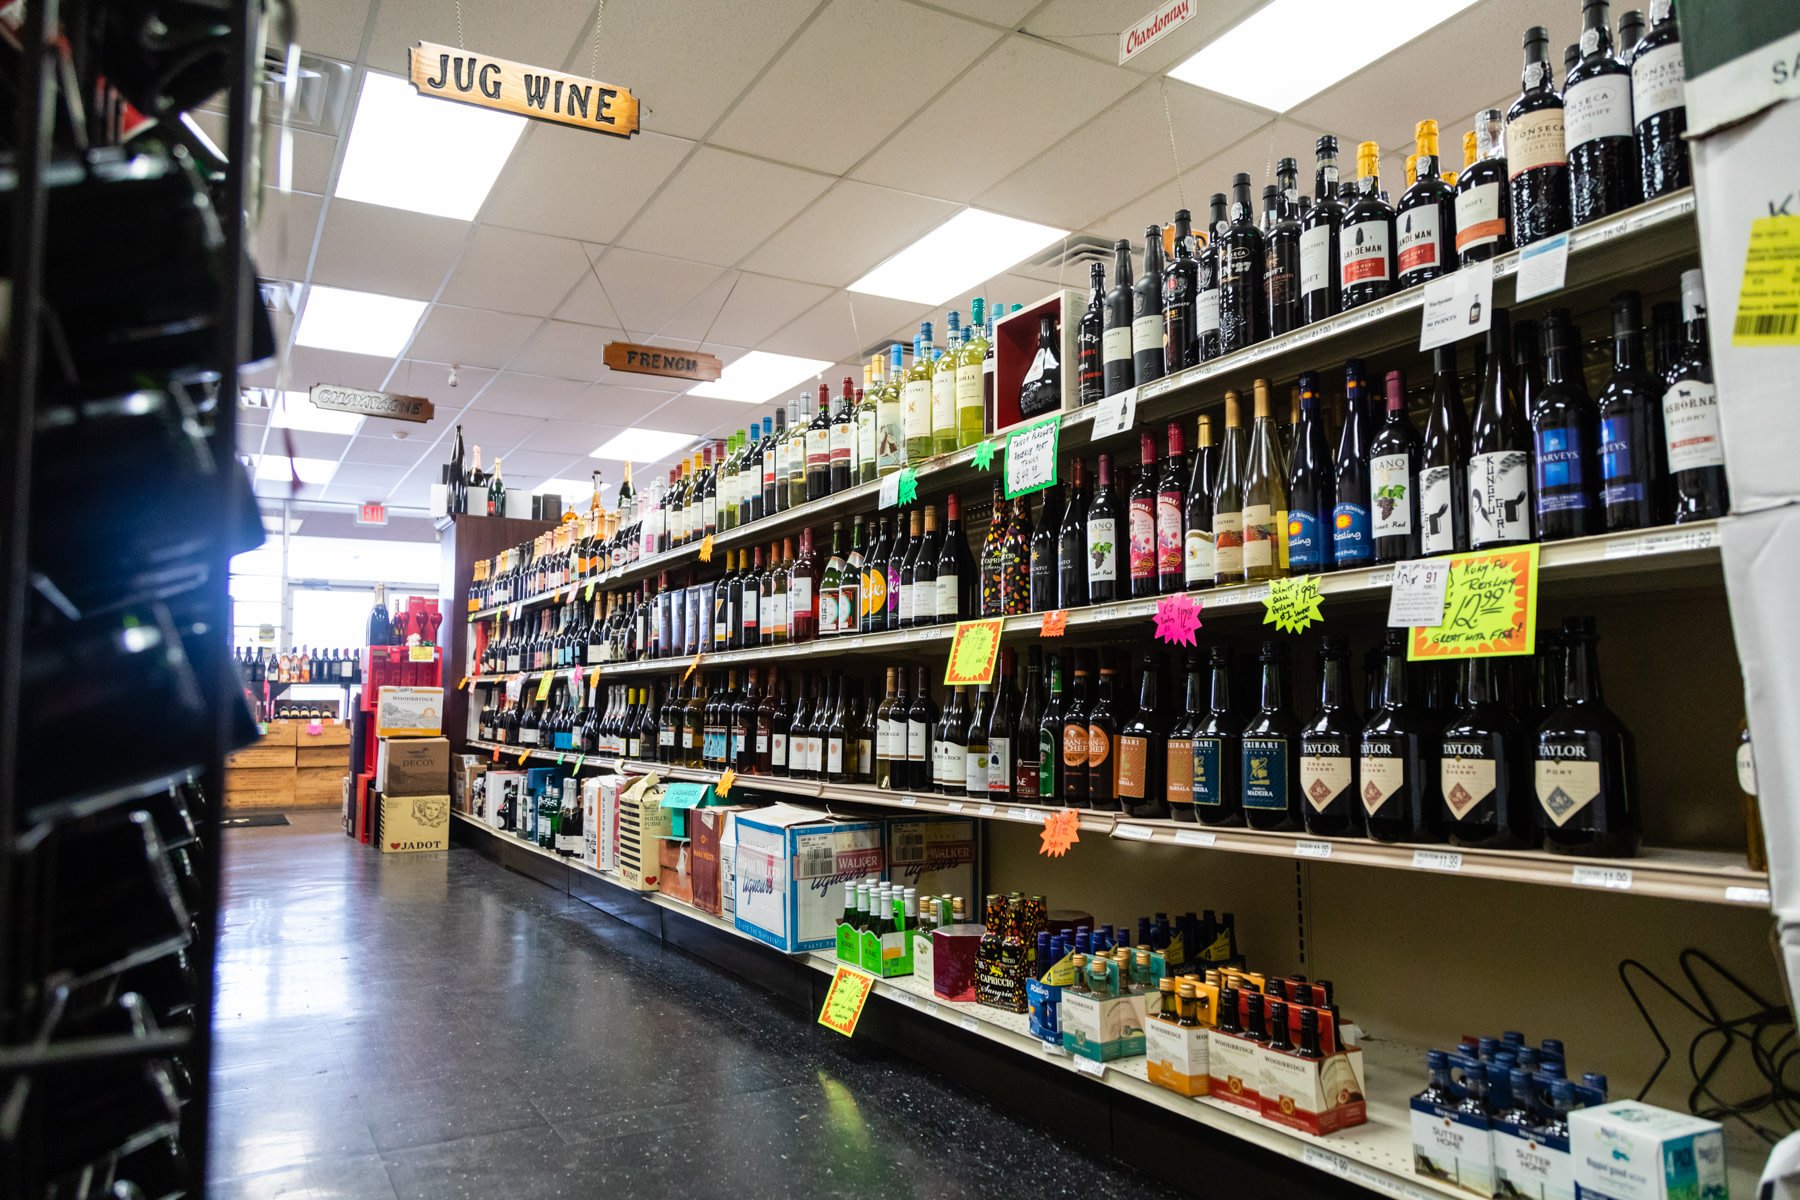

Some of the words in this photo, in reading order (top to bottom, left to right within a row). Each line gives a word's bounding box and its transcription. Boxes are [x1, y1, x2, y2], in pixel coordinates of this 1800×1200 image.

[1126, 0, 1189, 54] Chardonnay
[1636, 60, 1685, 84] FONSEC
[427, 54, 502, 100] JUG
[523, 74, 617, 125] WINE
[1514, 124, 1565, 141] FONSECA
[1397, 229, 1432, 248] ANDEMAN
[1434, 315, 1457, 327] POINTS
[626, 350, 698, 373] FRENCH
[319, 389, 423, 415] CHAMPAGNE
[1538, 451, 1580, 464] HARVEYS
[363, 505, 385, 522] EXIT
[1496, 498, 1506, 539] GIRL
[1392, 520, 1407, 529] Red
[1425, 571, 1438, 583] 91
[1432, 633, 1461, 643] GREAT
[1089, 745, 1106, 753] HEF
[1168, 741, 1191, 749] CRIBAR
[1243, 741, 1279, 749] CRIBARI
[1303, 743, 1341, 755] TAYLOR
[1361, 743, 1393, 755] TAYLOR
[1443, 743, 1484, 756] TAYLOR
[1539, 745, 1588, 758] TAYLOR
[402, 758, 436, 768] DECOY
[1247, 789, 1274, 797] MADEIRA
[401, 840, 442, 850] JADOT
[930, 847, 970, 859] WALKER
[838, 855, 878, 869] WALKER
[980, 973, 1015, 989] CAPRICCIO
[981, 985, 1014, 1001] Sangria
[1150, 1024, 1182, 1040] WOODBRIDGE
[1214, 1038, 1255, 1055] WOODBRIDGE
[1264, 1056, 1307, 1073] WOODBRIDGE
[1433, 1126, 1465, 1142] SUTTER
[1436, 1137, 1462, 1150] HOME
[1517, 1149, 1551, 1166] SUTTER
[1520, 1160, 1549, 1175] HOME
